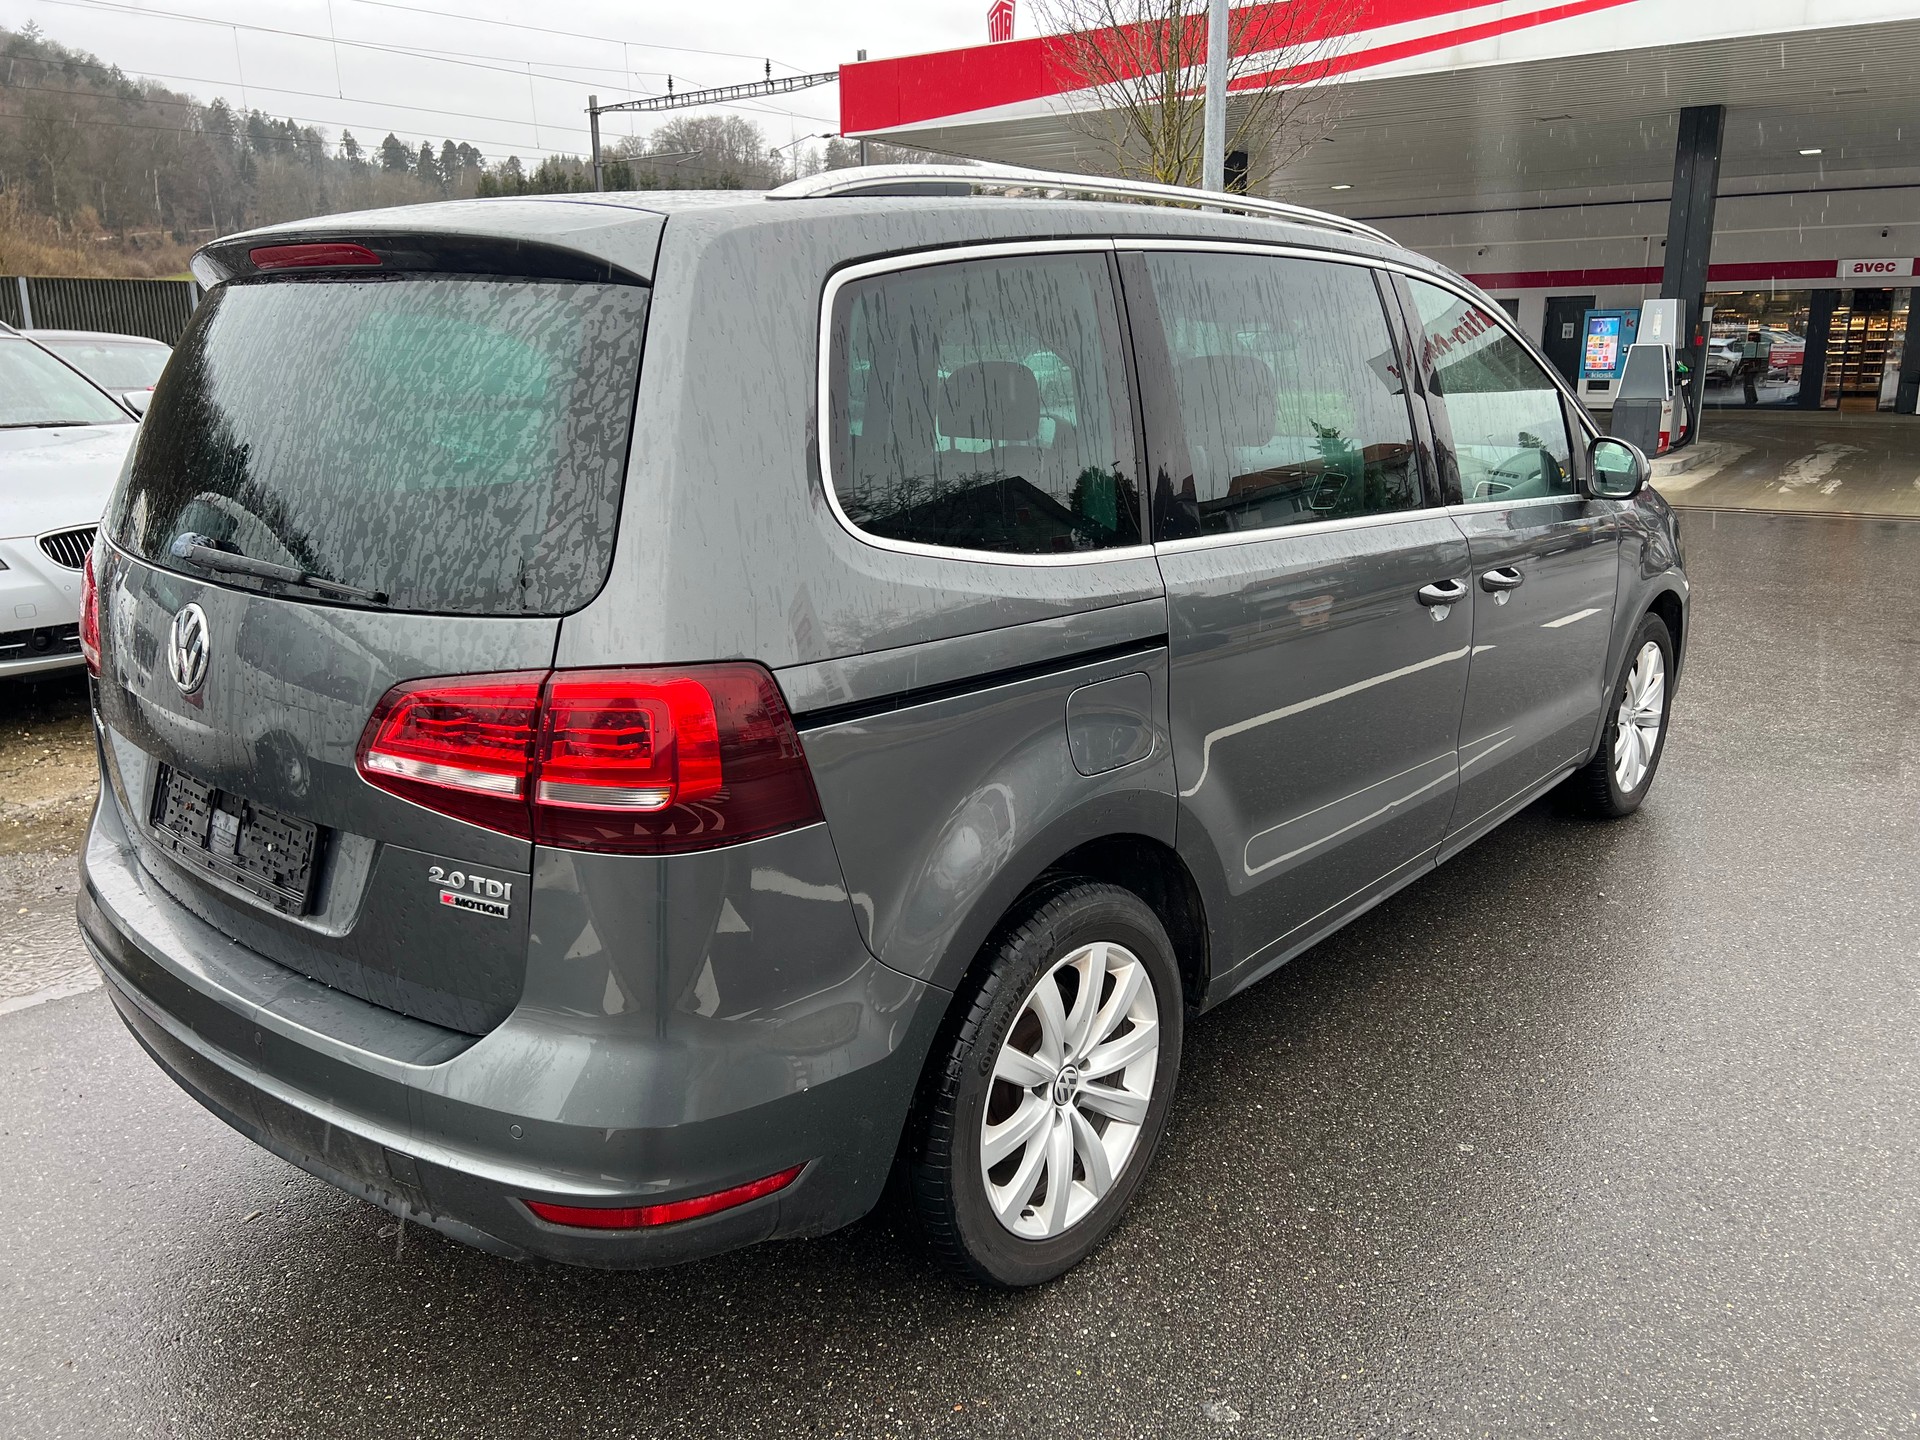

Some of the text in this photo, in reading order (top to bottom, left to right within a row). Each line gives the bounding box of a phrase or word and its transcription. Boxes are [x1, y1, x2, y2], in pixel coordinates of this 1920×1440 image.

[1853, 262, 1896, 273] avec
[1591, 371, 1614, 379] kiosk
[469, 875, 512, 901] TDI
